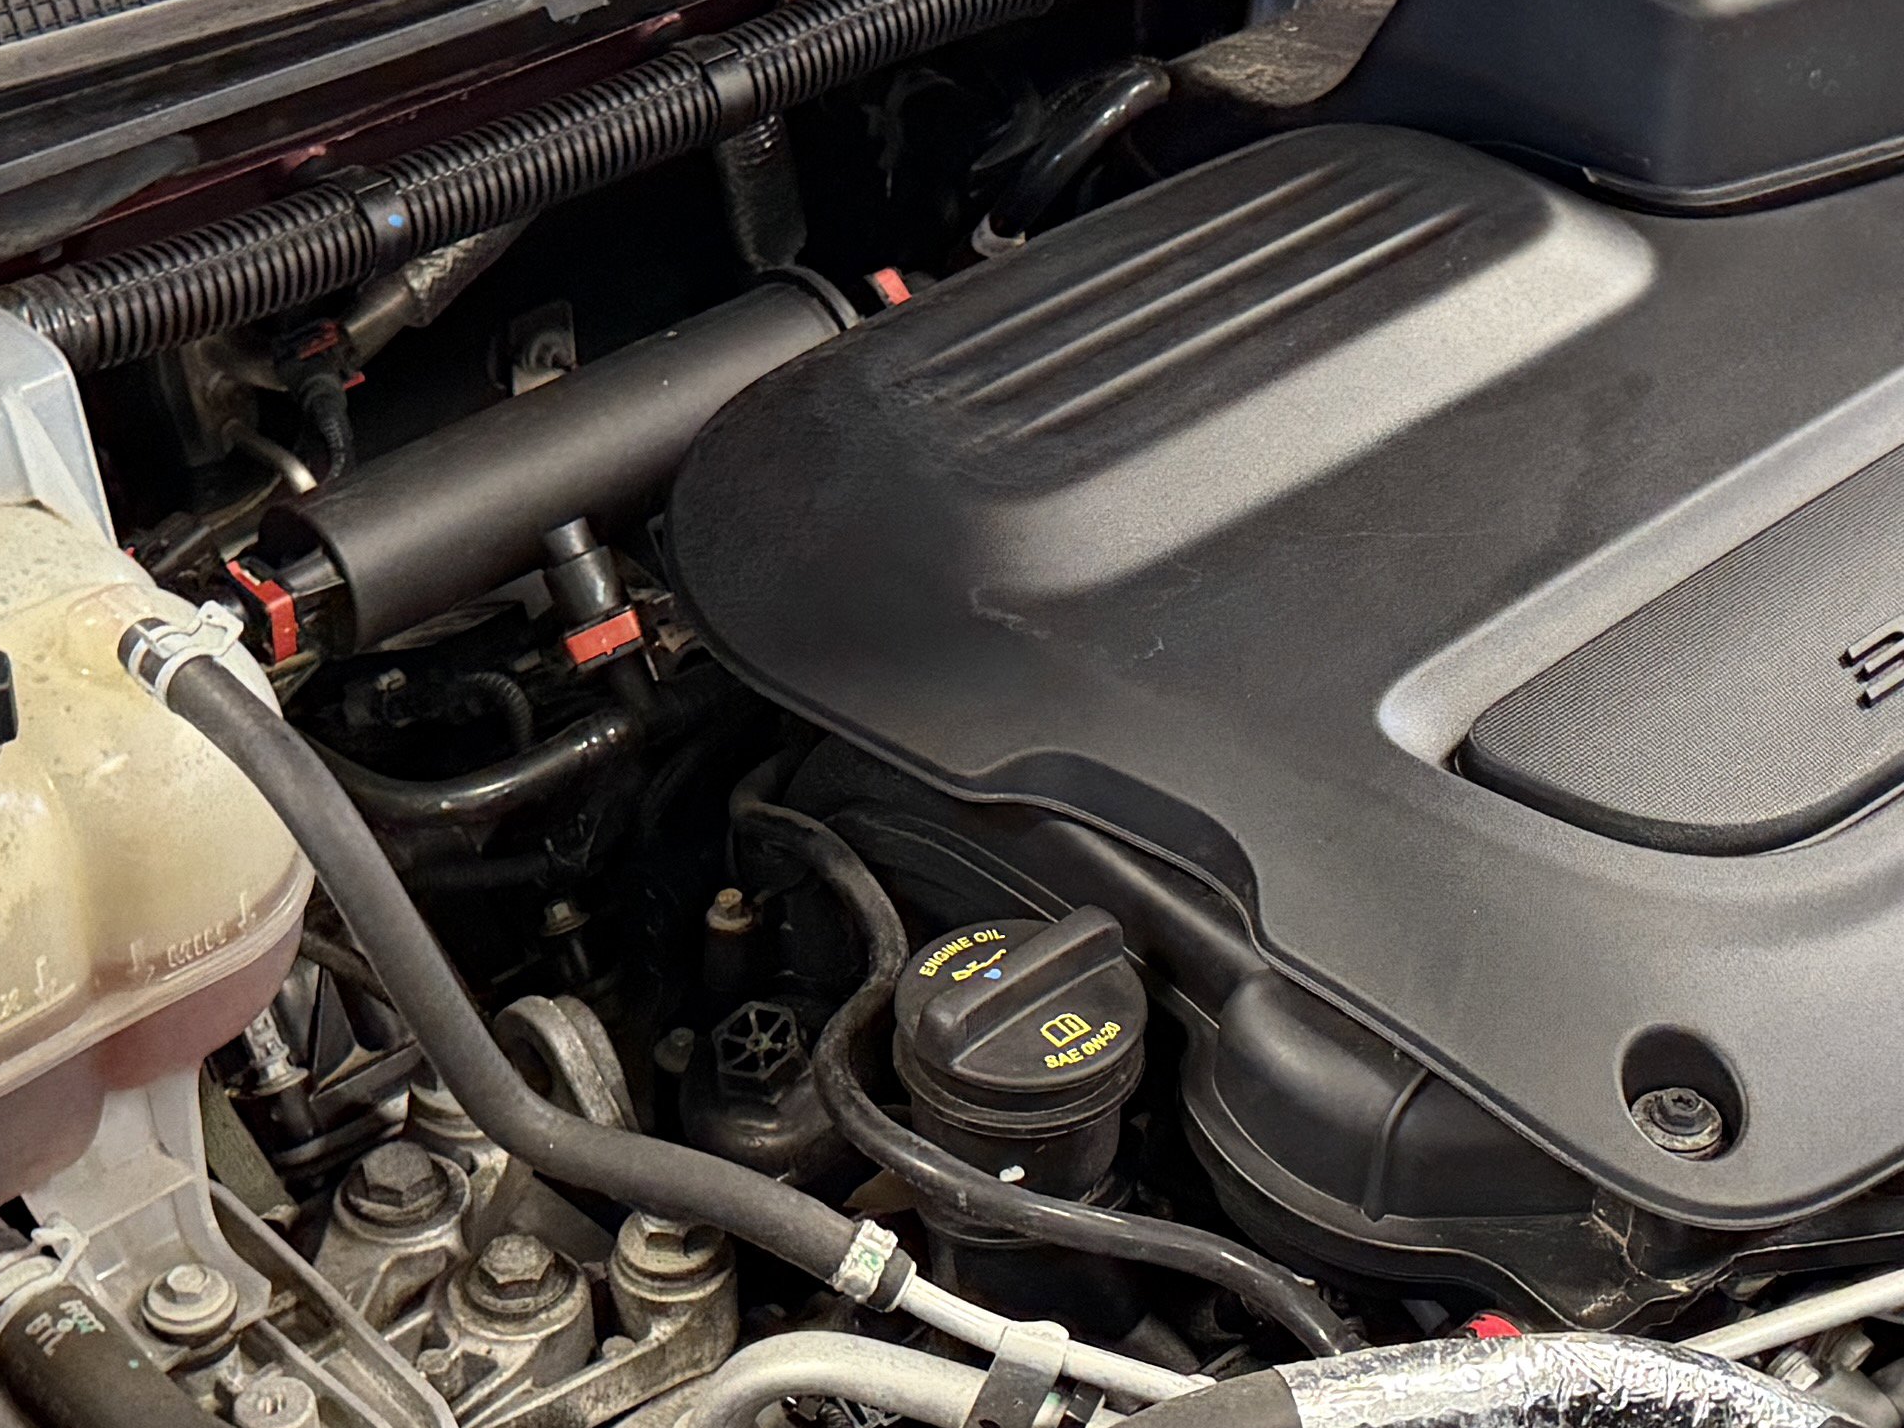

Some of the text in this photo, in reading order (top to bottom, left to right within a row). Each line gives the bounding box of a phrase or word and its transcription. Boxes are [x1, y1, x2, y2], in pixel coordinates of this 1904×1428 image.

[918, 928, 1007, 978] ENGINE OIL
[1044, 1021, 1122, 1069] SAE 0W-20
